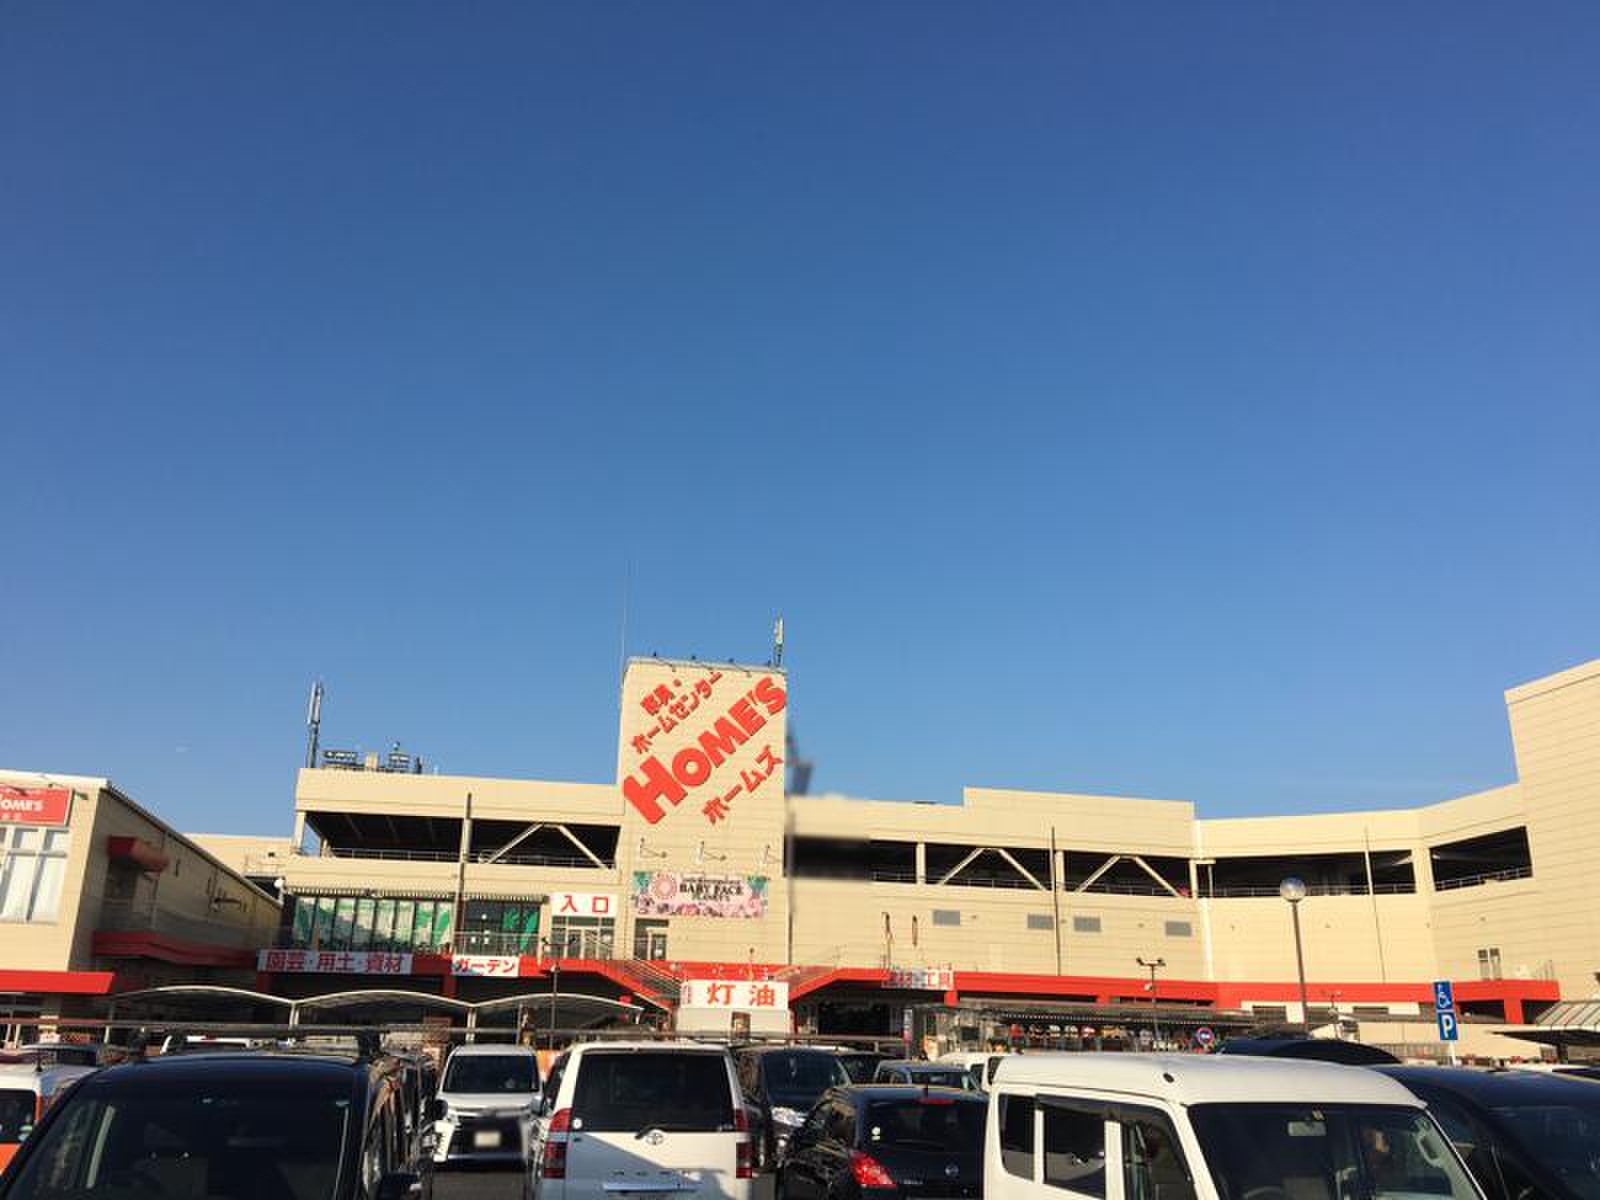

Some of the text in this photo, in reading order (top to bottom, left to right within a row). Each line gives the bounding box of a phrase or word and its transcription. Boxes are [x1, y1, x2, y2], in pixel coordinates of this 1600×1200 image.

[631, 671, 723, 754] ホームセンター
[623, 676, 787, 825] HOME'S
[702, 744, 784, 825] ホームズ
[560, 895, 609, 914] 入口
[453, 958, 516, 974] ガーデン
[706, 982, 776, 1007] 灯油
[1441, 1014, 1454, 1039] P
